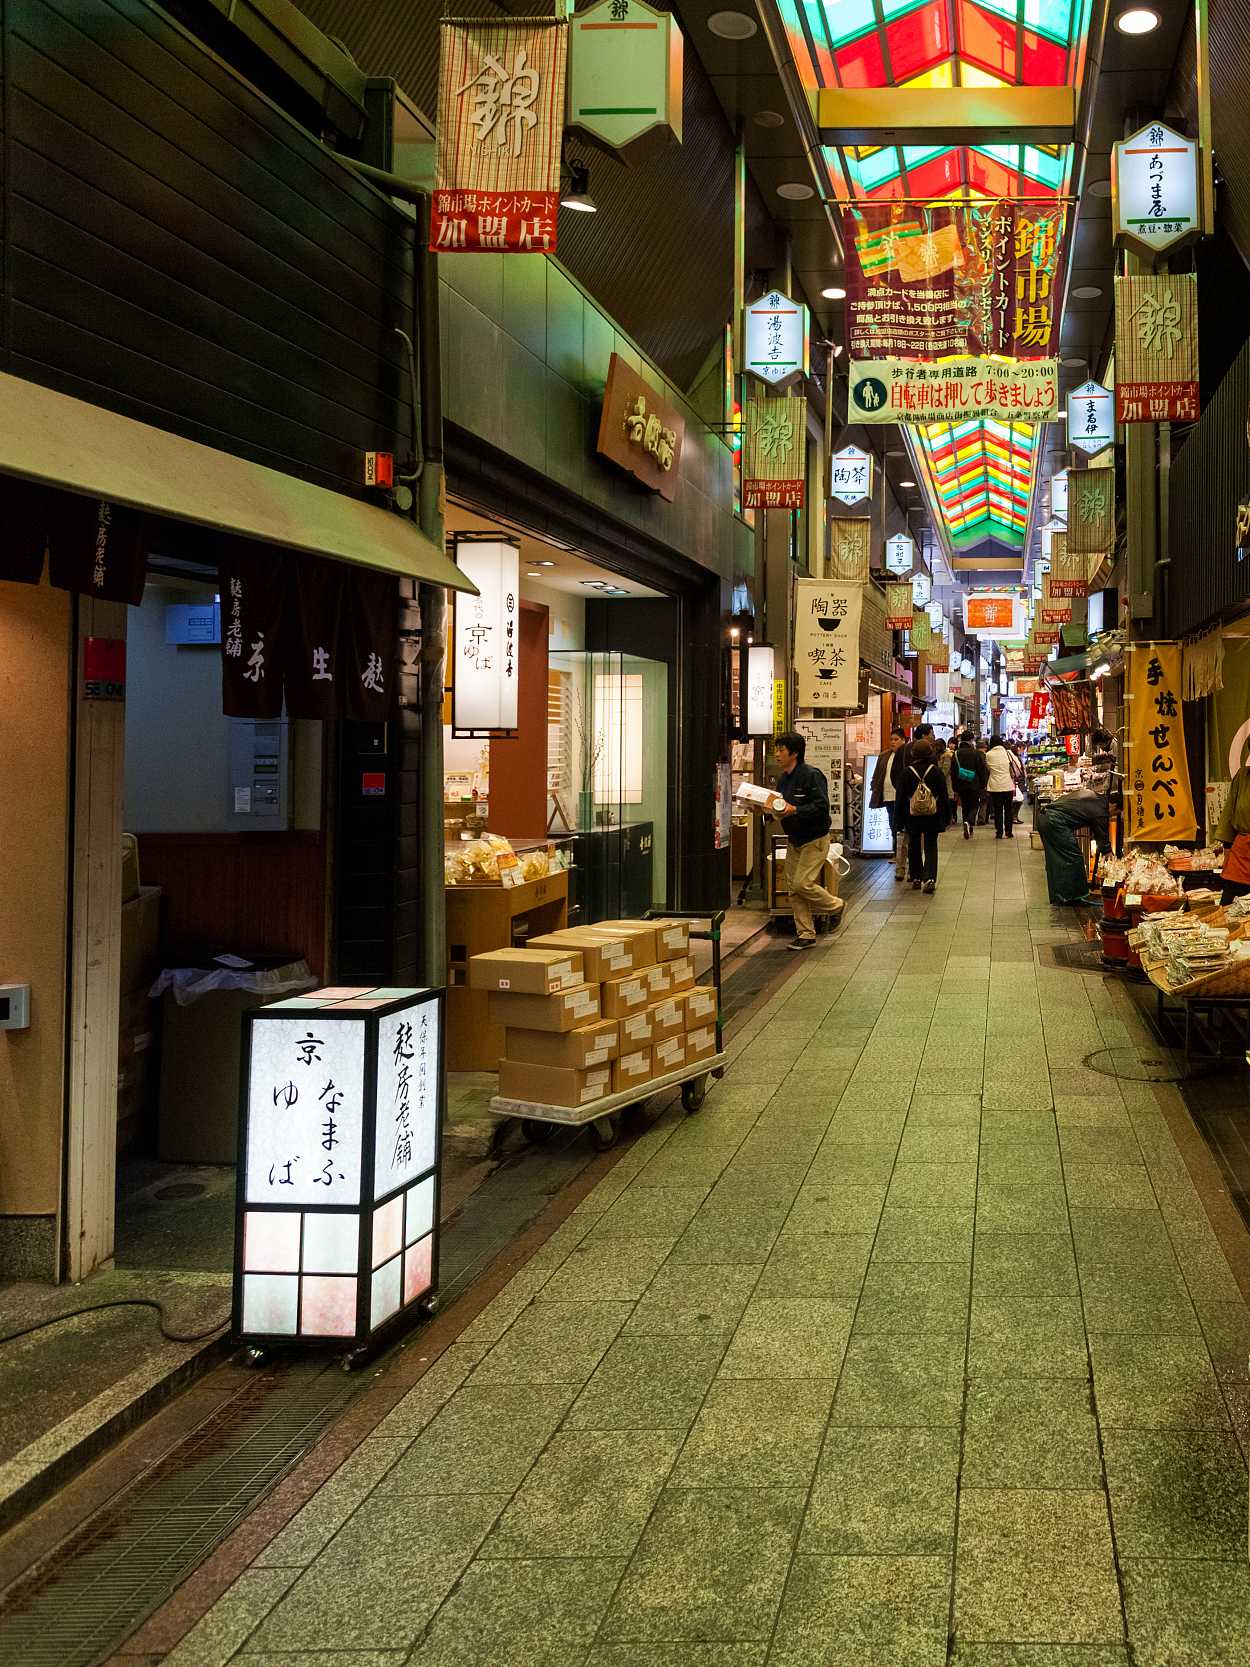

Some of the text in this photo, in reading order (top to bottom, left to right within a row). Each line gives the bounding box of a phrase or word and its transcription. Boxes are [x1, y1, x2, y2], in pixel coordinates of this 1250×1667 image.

[456, 50, 540, 159] 錦
[1148, 127, 1164, 147] 錦
[1147, 154, 1167, 217] あづま屋
[438, 194, 553, 215] 錦市場ポイントカード
[435, 215, 552, 250] 加盟店
[994, 215, 1013, 349] ポイントカード
[1012, 217, 1055, 348] 錦市場
[767, 315, 784, 361] 湯波吉
[1121, 290, 1183, 359] 錦
[891, 366, 977, 379] 歩行者専用道路
[891, 379, 1055, 411] 自転車は押して歩きましょう
[1120, 384, 1196, 399] 錦市場ポイントカード
[1085, 399, 1099, 435] まる伊
[1120, 400, 1197, 421] 加盟店
[753, 415, 793, 464] 錦
[745, 491, 802, 508] 加盟店
[1074, 488, 1105, 528] 錦
[839, 535, 862, 566] 錦
[811, 598, 848, 616] 陶器
[808, 650, 846, 667] 喫茶
[1146, 657, 1178, 821] 手焼せんべい
[295, 1032, 325, 1066] 京
[268, 1080, 300, 1187] ゆば
[313, 1079, 345, 1187] なまふ
